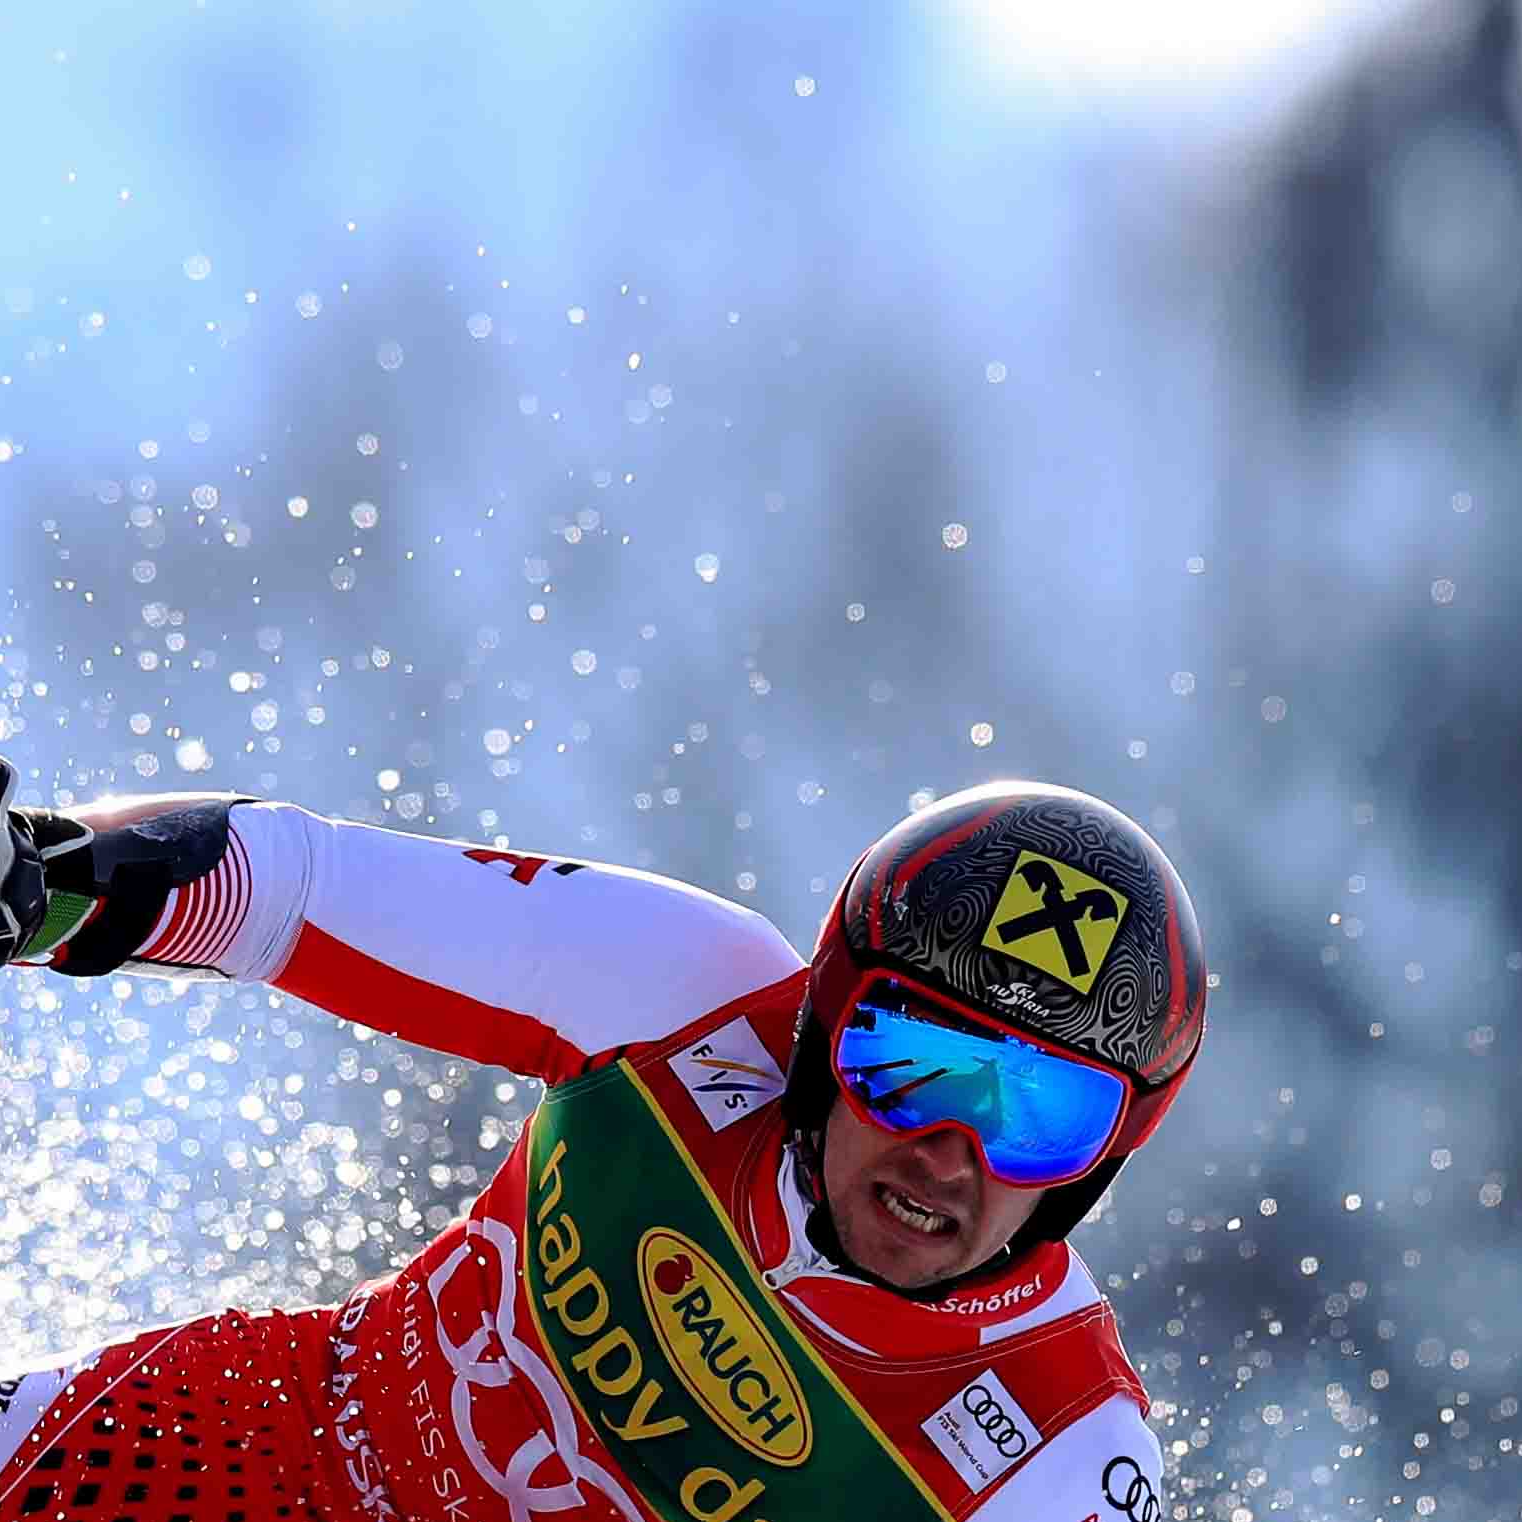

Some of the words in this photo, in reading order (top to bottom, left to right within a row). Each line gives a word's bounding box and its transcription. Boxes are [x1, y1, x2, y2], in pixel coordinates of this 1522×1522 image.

[536, 1139, 691, 1440] happy
[408, 1380, 445, 1456] FIS
[671, 1291, 796, 1444] RAUCH
[975, 1463, 989, 1480] Cup
